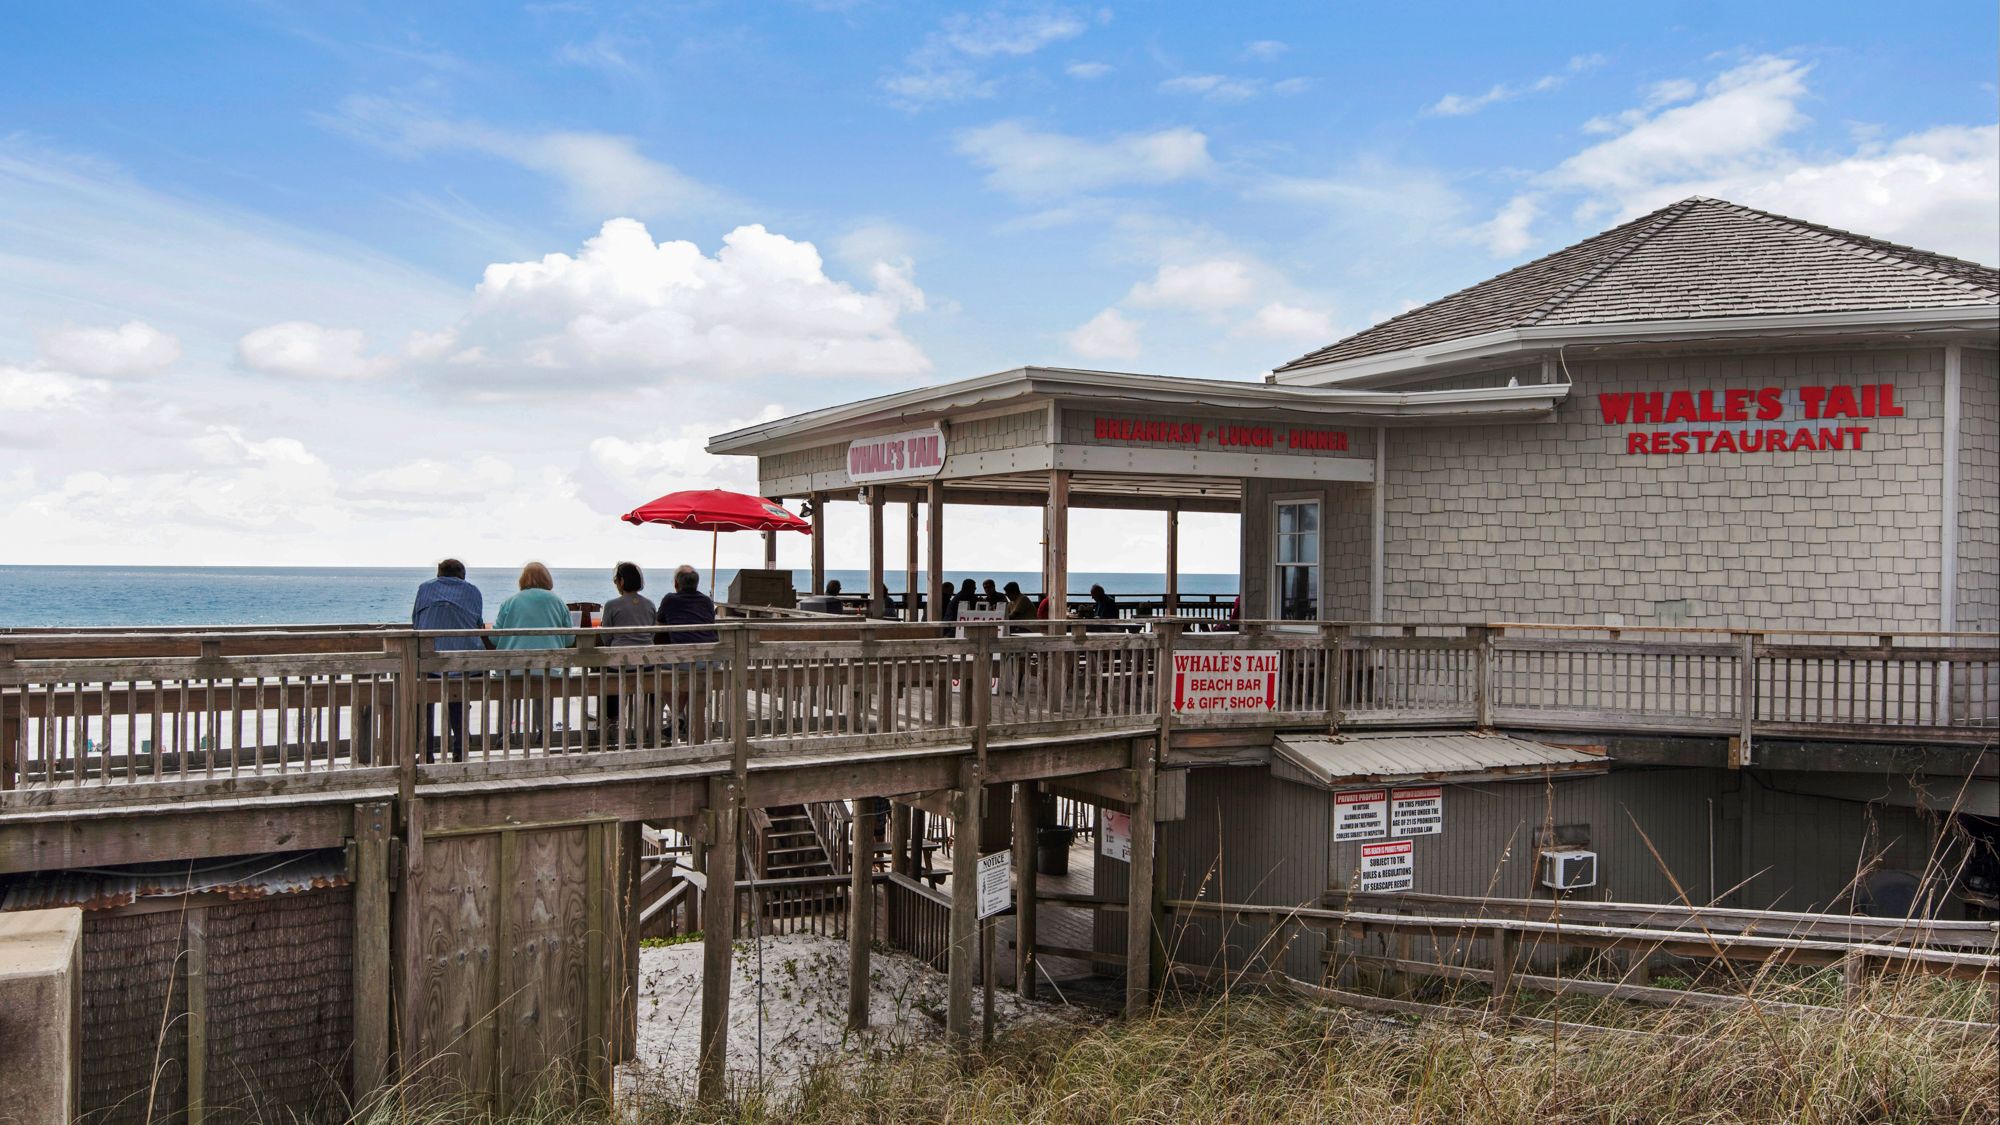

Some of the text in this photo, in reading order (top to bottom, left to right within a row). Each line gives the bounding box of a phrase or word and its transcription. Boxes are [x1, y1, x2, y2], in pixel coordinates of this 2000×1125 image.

[1598, 384, 1904, 424] WHALE'S TAIL
[1094, 417, 1348, 451] BREAKFAST LUNCH DINNER
[1628, 427, 1869, 455] RESTAURANT
[850, 435, 941, 475] WHALE'S TAIL
[1174, 655, 1278, 672] WHALE'S TAIL
[1191, 679, 1261, 691] BEACH BAR
[1186, 696, 1263, 709] & GIFT SHOP
[1337, 794, 1359, 803] PRIVATE
[1359, 792, 1384, 802] PROPERTY
[983, 855, 1004, 869] NOTICE
[1370, 858, 1389, 866] SUBJECT
[1397, 856, 1405, 864] THE
[1363, 871, 1377, 879] RULES
[1382, 867, 1411, 877] REGULATIONS
[1370, 881, 1393, 890] SEASCAPE
[1394, 879, 1411, 888] RESORT
